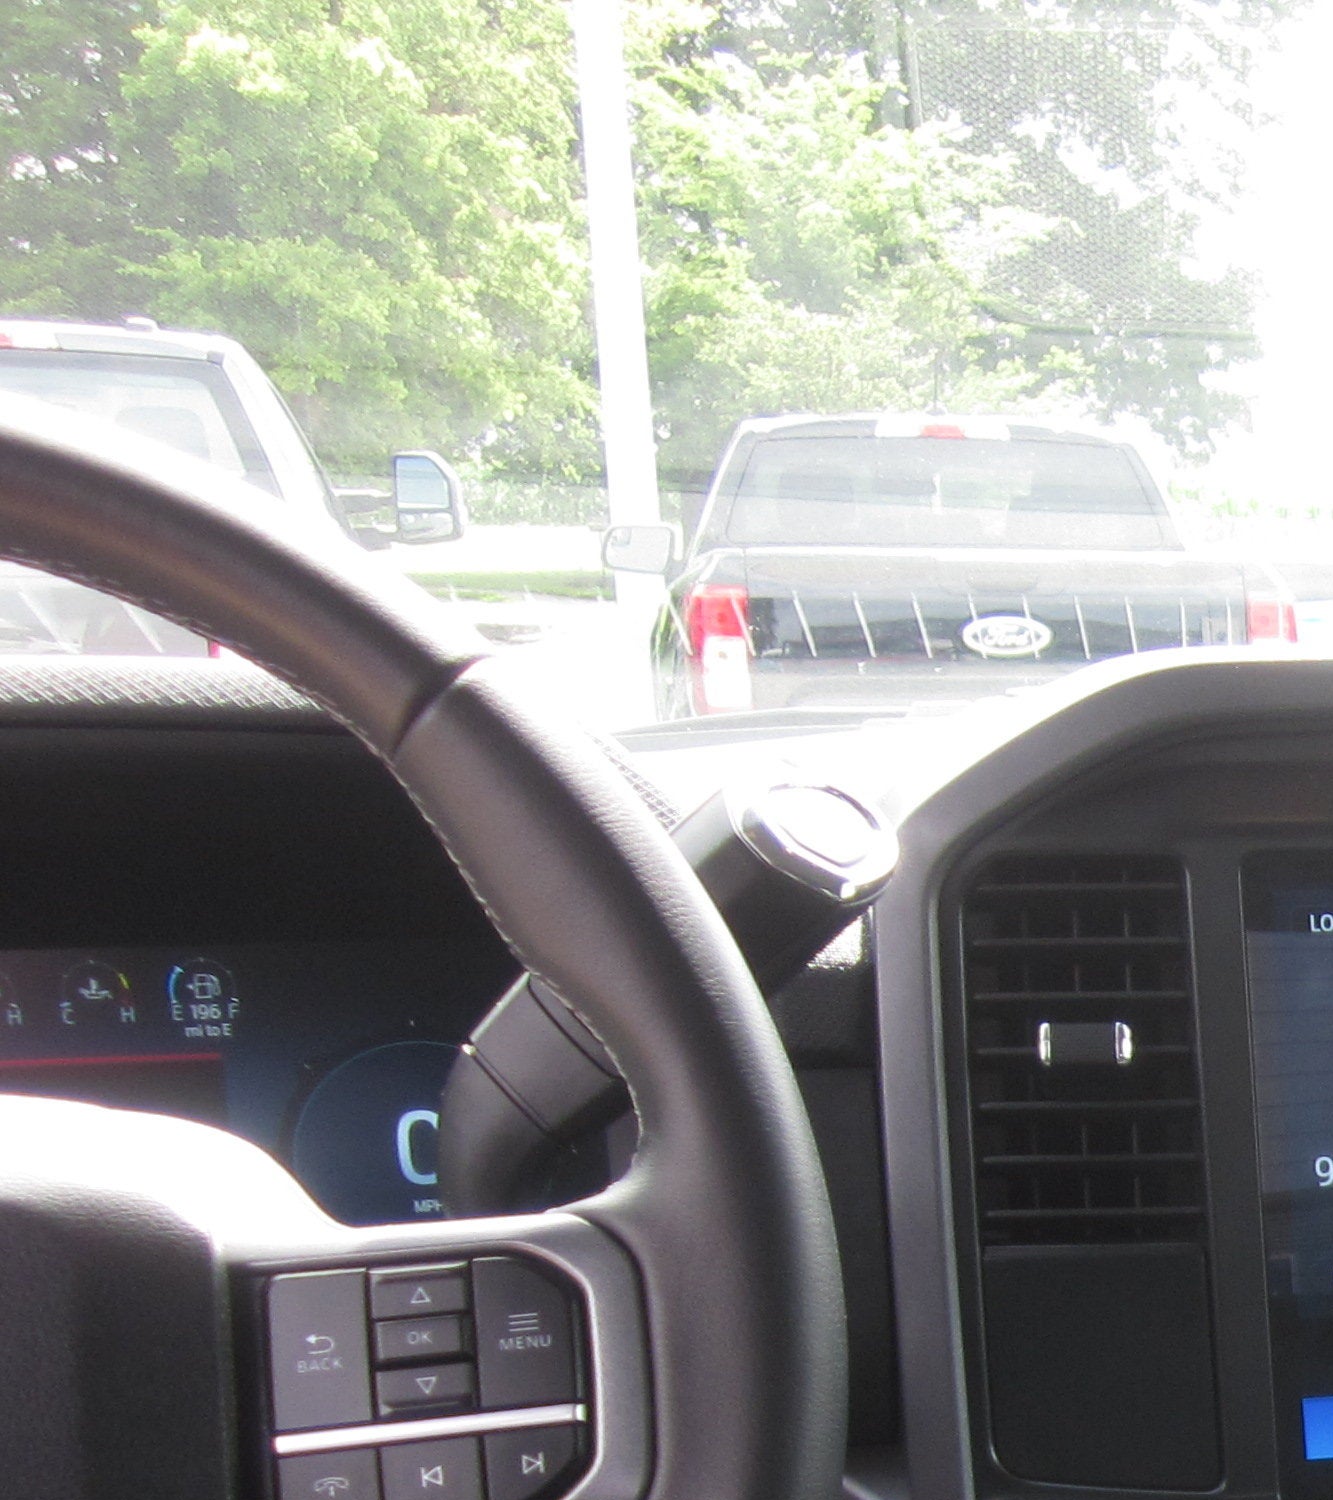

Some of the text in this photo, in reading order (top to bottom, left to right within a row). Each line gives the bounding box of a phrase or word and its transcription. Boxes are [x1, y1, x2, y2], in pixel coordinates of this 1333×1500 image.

[171, 1004, 184, 1021] E
[189, 1003, 222, 1021] 196
[184, 1023, 233, 1037] mi to E
[406, 1330, 433, 1345] OK
[499, 1334, 552, 1351] MENU
[297, 1357, 344, 1374] BACK
